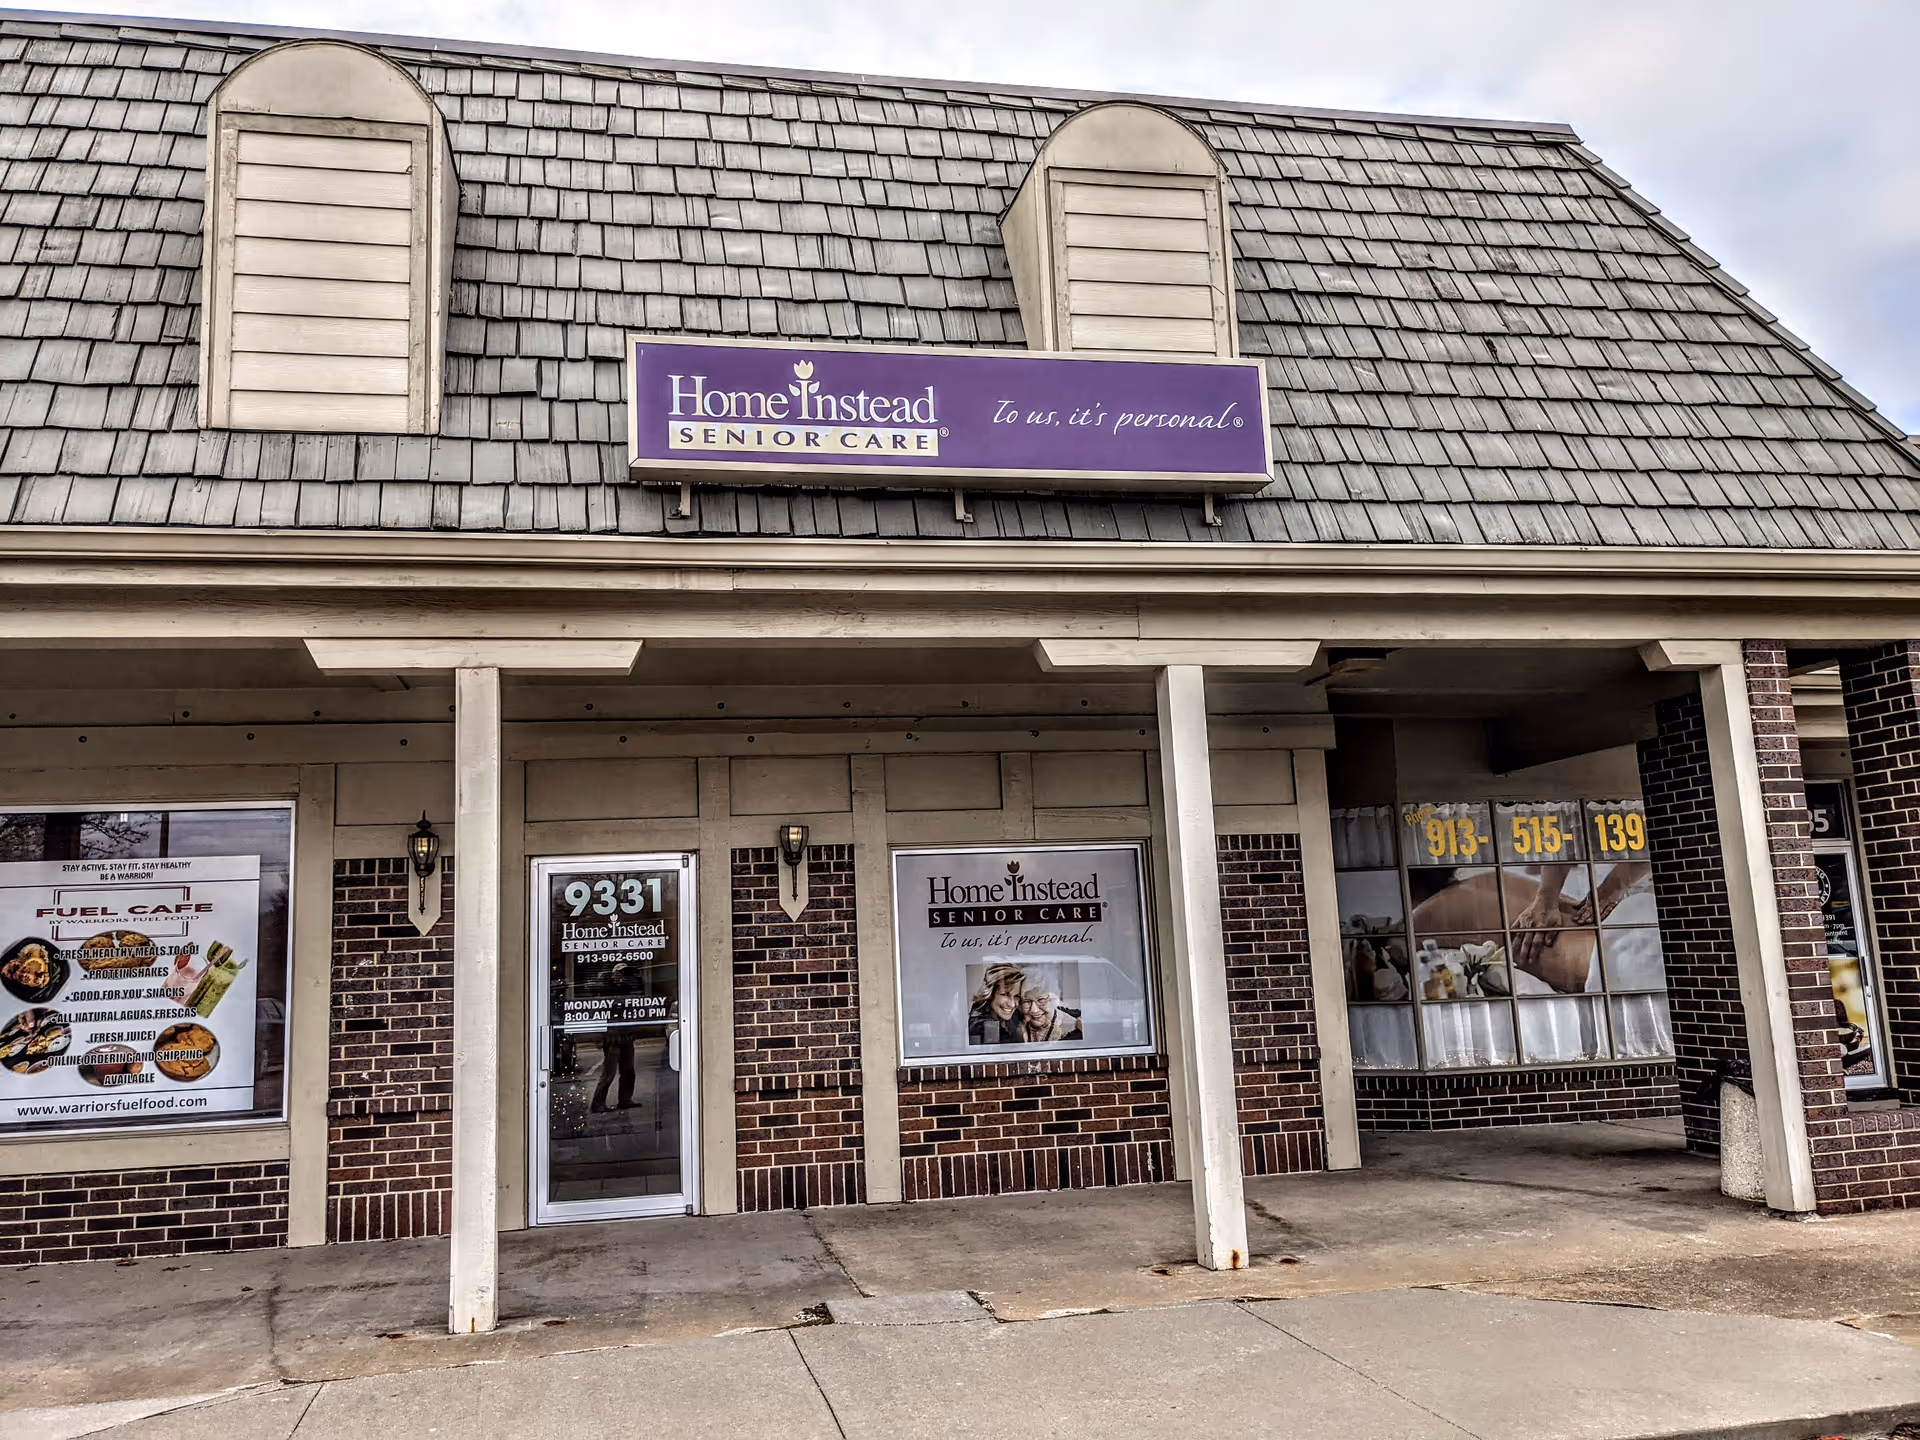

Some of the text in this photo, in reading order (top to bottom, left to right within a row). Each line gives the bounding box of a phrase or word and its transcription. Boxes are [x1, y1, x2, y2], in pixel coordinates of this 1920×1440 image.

[668, 374, 939, 424] Home Instead
[992, 400, 1018, 424] To
[1026, 410, 1060, 428] us,
[1068, 402, 1108, 427] it's
[680, 427, 929, 450] SENIOR CARE
[1426, 813, 1646, 857] 913- 515- 139
[62, 864, 80, 872] STAY
[110, 863, 127, 871] STAY
[142, 862, 159, 870] STAY
[118, 872, 154, 880] WARRIOR!
[927, 873, 1101, 905] Home Instead
[564, 878, 661, 917] 9331
[36, 903, 213, 918] FUEL CAFE
[933, 907, 1097, 924] SENIOR CARE
[562, 920, 665, 939] Home Instead
[564, 938, 662, 950] SENIOR CARE
[941, 932, 957, 948] To
[961, 937, 983, 948] us,
[988, 930, 1012, 946] it's
[60, 944, 199, 960] FRESH HEALTHY MEALS TO GO!
[577, 951, 654, 963] 913-962-6500
[90, 967, 169, 979] PROTEIN SHAKES
[103, 990, 121, 1000] FOR
[146, 987, 185, 999] SNACKS
[564, 999, 615, 1010] MONDAY
[625, 997, 667, 1007] FRIDAY
[57, 1007, 197, 1023] ALL NATURAL AGUAS FRESCAS
[565, 1012, 589, 1022] 8:00
[592, 1011, 611, 1020] AM
[649, 1008, 666, 1018] PM
[48, 1049, 203, 1066] ONLINE ORDERING AND SHIPPING
[104, 1073, 155, 1085] AVAILABLE
[17, 1096, 207, 1116] www.warriorsfuelfood.com
